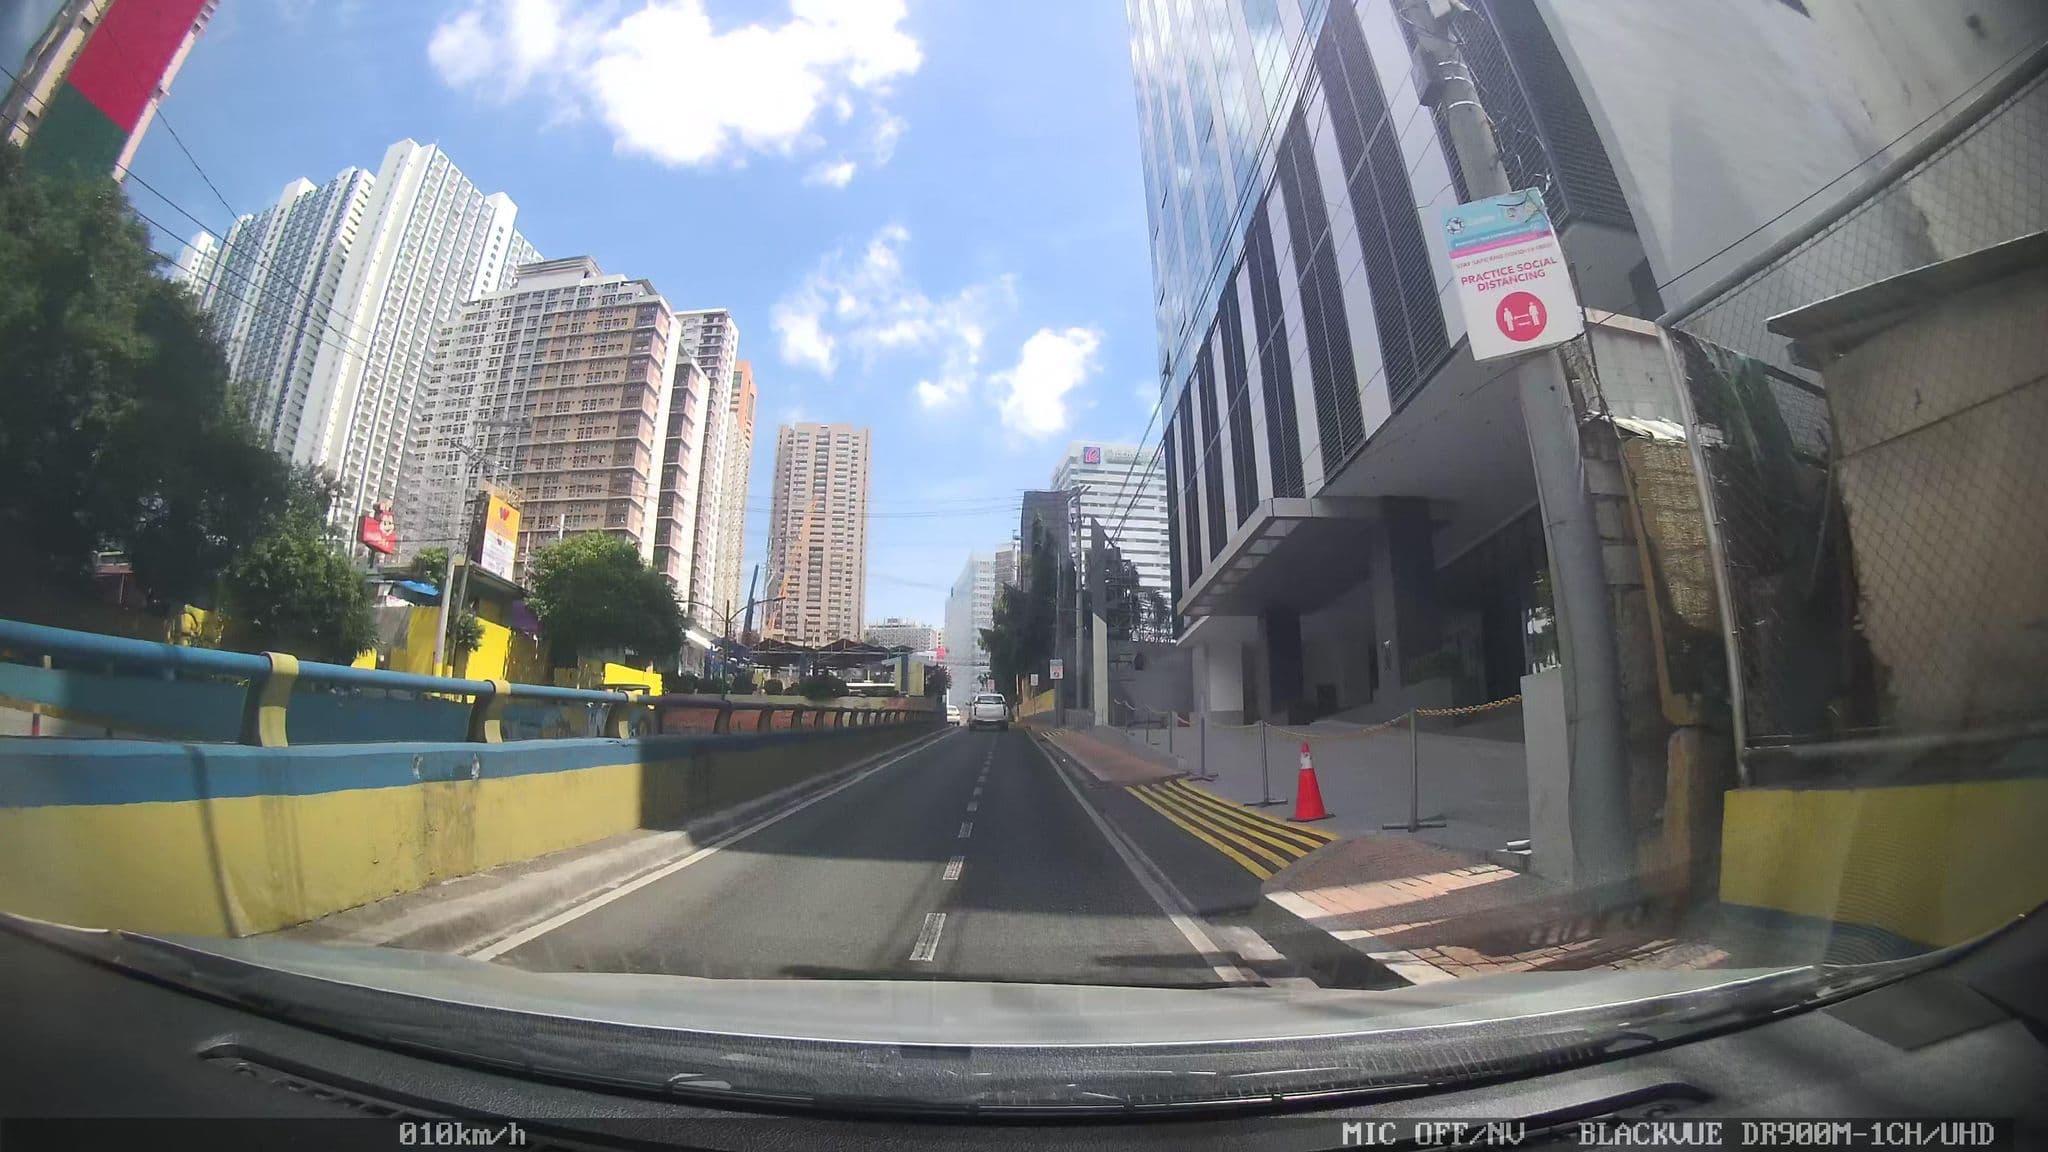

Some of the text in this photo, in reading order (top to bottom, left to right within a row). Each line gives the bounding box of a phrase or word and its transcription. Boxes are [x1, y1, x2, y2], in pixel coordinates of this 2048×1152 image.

[1461, 257, 1558, 285] PRACTICE SOCIAL
[1477, 270, 1546, 291] DISTANCING
